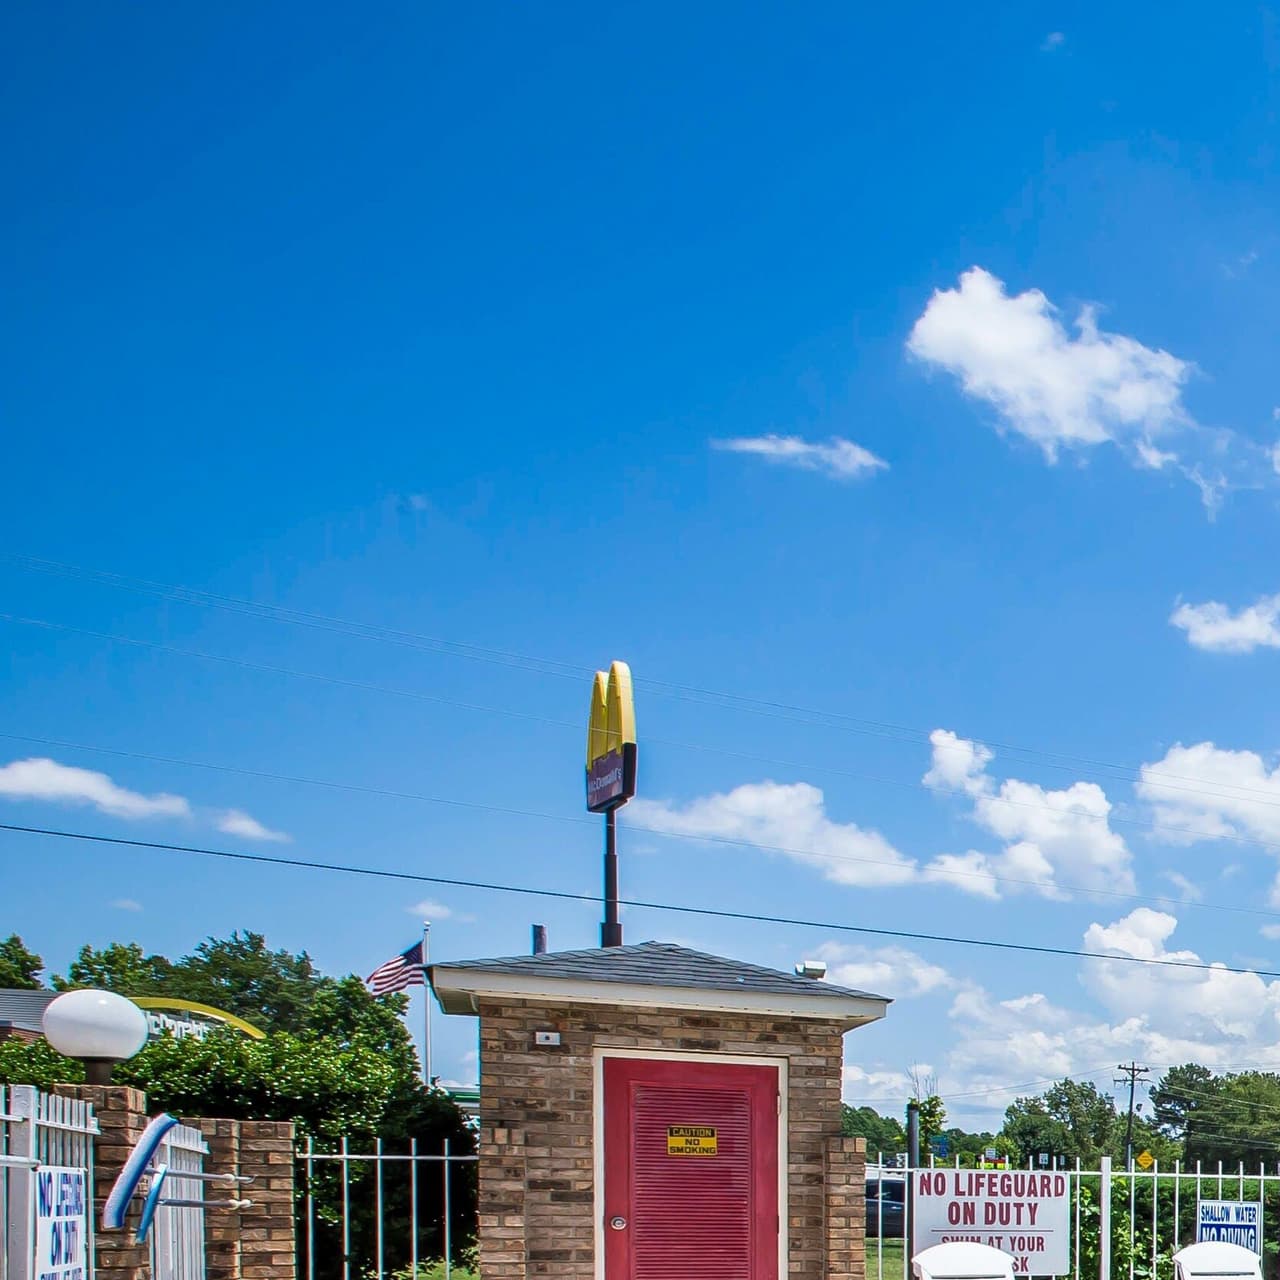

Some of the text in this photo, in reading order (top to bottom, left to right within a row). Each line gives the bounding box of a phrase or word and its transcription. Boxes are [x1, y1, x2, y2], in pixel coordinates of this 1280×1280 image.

[672, 1128, 713, 1136] CAUTION
[670, 1146, 717, 1154] SMOKING
[38, 1171, 52, 1217] NO
[919, 1172, 1065, 1197] NO LIFEGUARD
[948, 1202, 1039, 1226] ON DUTY
[1201, 1205, 1256, 1222] SHALLOW WATER
[51, 1221, 62, 1266] ON
[1009, 1236, 1045, 1251] YOUR
[1202, 1227, 1255, 1250] NO DIVING
[1012, 1256, 1029, 1272] SK
